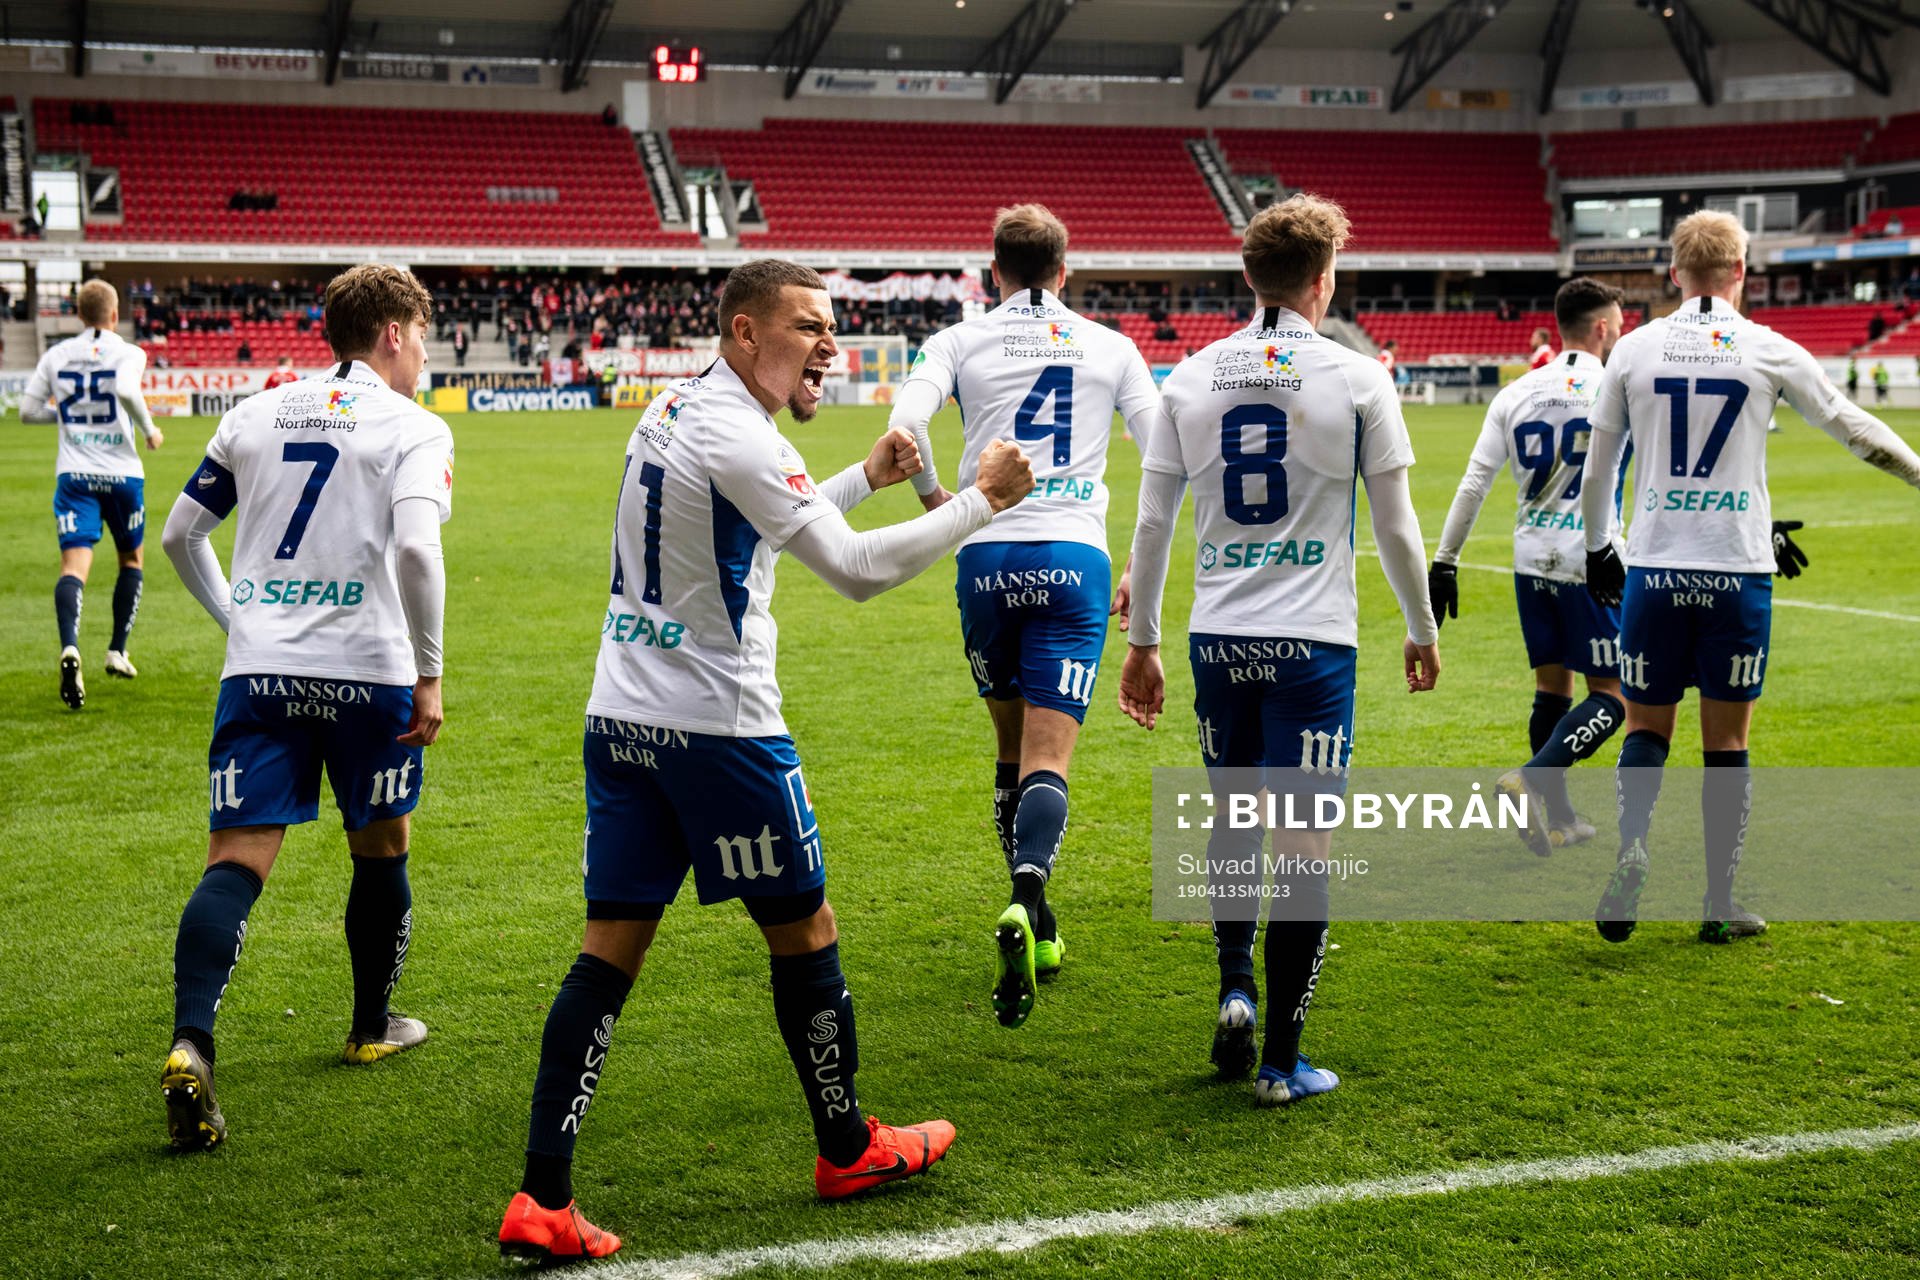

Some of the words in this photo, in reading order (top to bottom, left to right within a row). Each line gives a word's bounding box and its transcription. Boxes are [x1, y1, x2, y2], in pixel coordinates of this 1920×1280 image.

[1004, 346, 1084, 360] Norrköping
[1213, 361, 1262, 378] create
[1210, 375, 1302, 392] Norrköping
[58, 370, 116, 424] 25
[277, 403, 324, 416] create
[471, 388, 593, 412] Caverion
[273, 416, 358, 433] Norrköping
[1014, 365, 1073, 467] 4
[1654, 377, 1750, 478] 17
[1221, 403, 1289, 526] 8
[1513, 417, 1593, 501] 99
[274, 441, 340, 560] 7
[1027, 478, 1094, 501] EFAB
[1663, 489, 1750, 512] SEFAB
[1223, 540, 1326, 568] SEFAB
[260, 580, 365, 606] SEFAB
[974, 568, 1084, 593] MÅNSSON
[1645, 570, 1743, 592] MÅNSSON
[1004, 588, 1050, 609] RÖR
[1672, 589, 1715, 608] RÖR
[1198, 641, 1313, 663] MÅNSSON
[1228, 661, 1278, 684] RÖR
[248, 674, 374, 704] MÅNSSON
[286, 699, 338, 722] RÖR
[608, 741, 660, 770] RÖR
[1299, 724, 1348, 777] nt
[369, 757, 416, 807] nt
[713, 824, 785, 881] nt
[804, 838, 822, 872] 11
